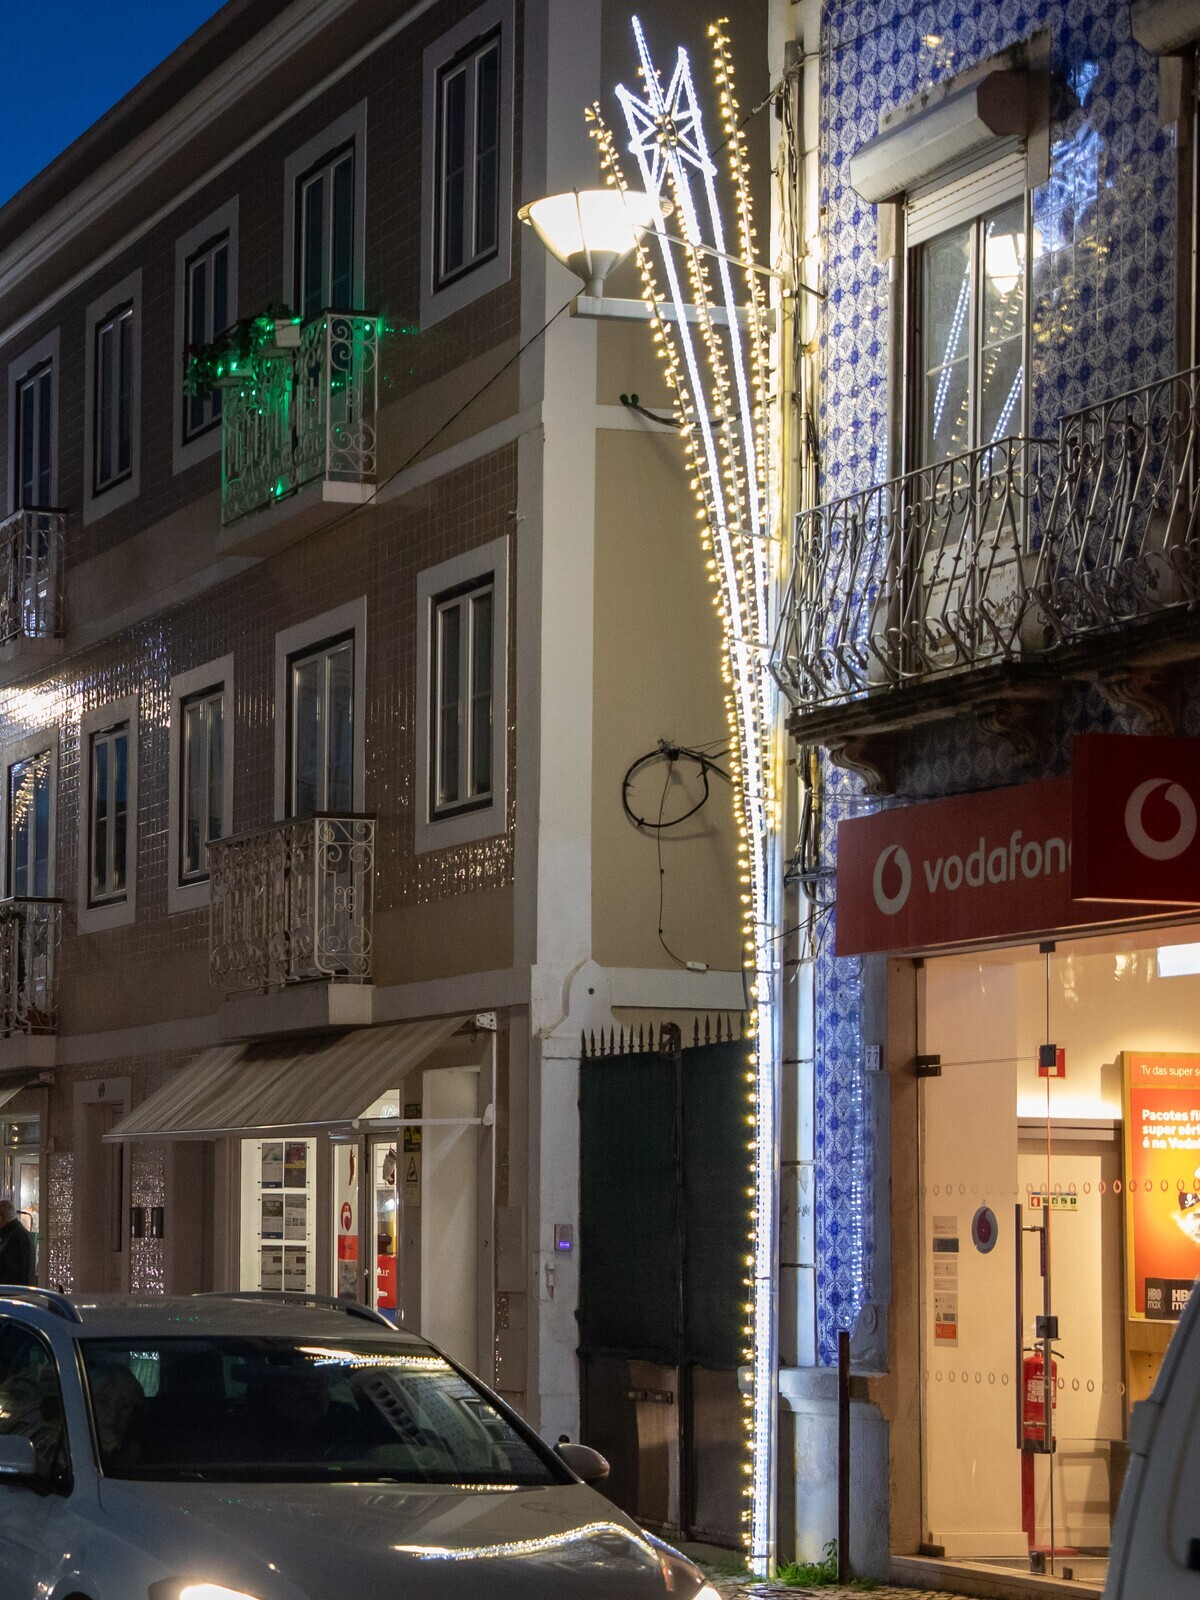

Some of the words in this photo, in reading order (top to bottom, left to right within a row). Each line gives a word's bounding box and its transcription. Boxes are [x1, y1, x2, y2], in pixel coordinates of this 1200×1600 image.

[923, 830, 1071, 894] vodafon
[1152, 1066, 1167, 1075] das
[1169, 1067, 1193, 1078] super
[1142, 1109, 1188, 1121] Pacotes
[1142, 1125, 1177, 1137] super
[1142, 1136, 1150, 1149] é
[1151, 1139, 1167, 1149] na
